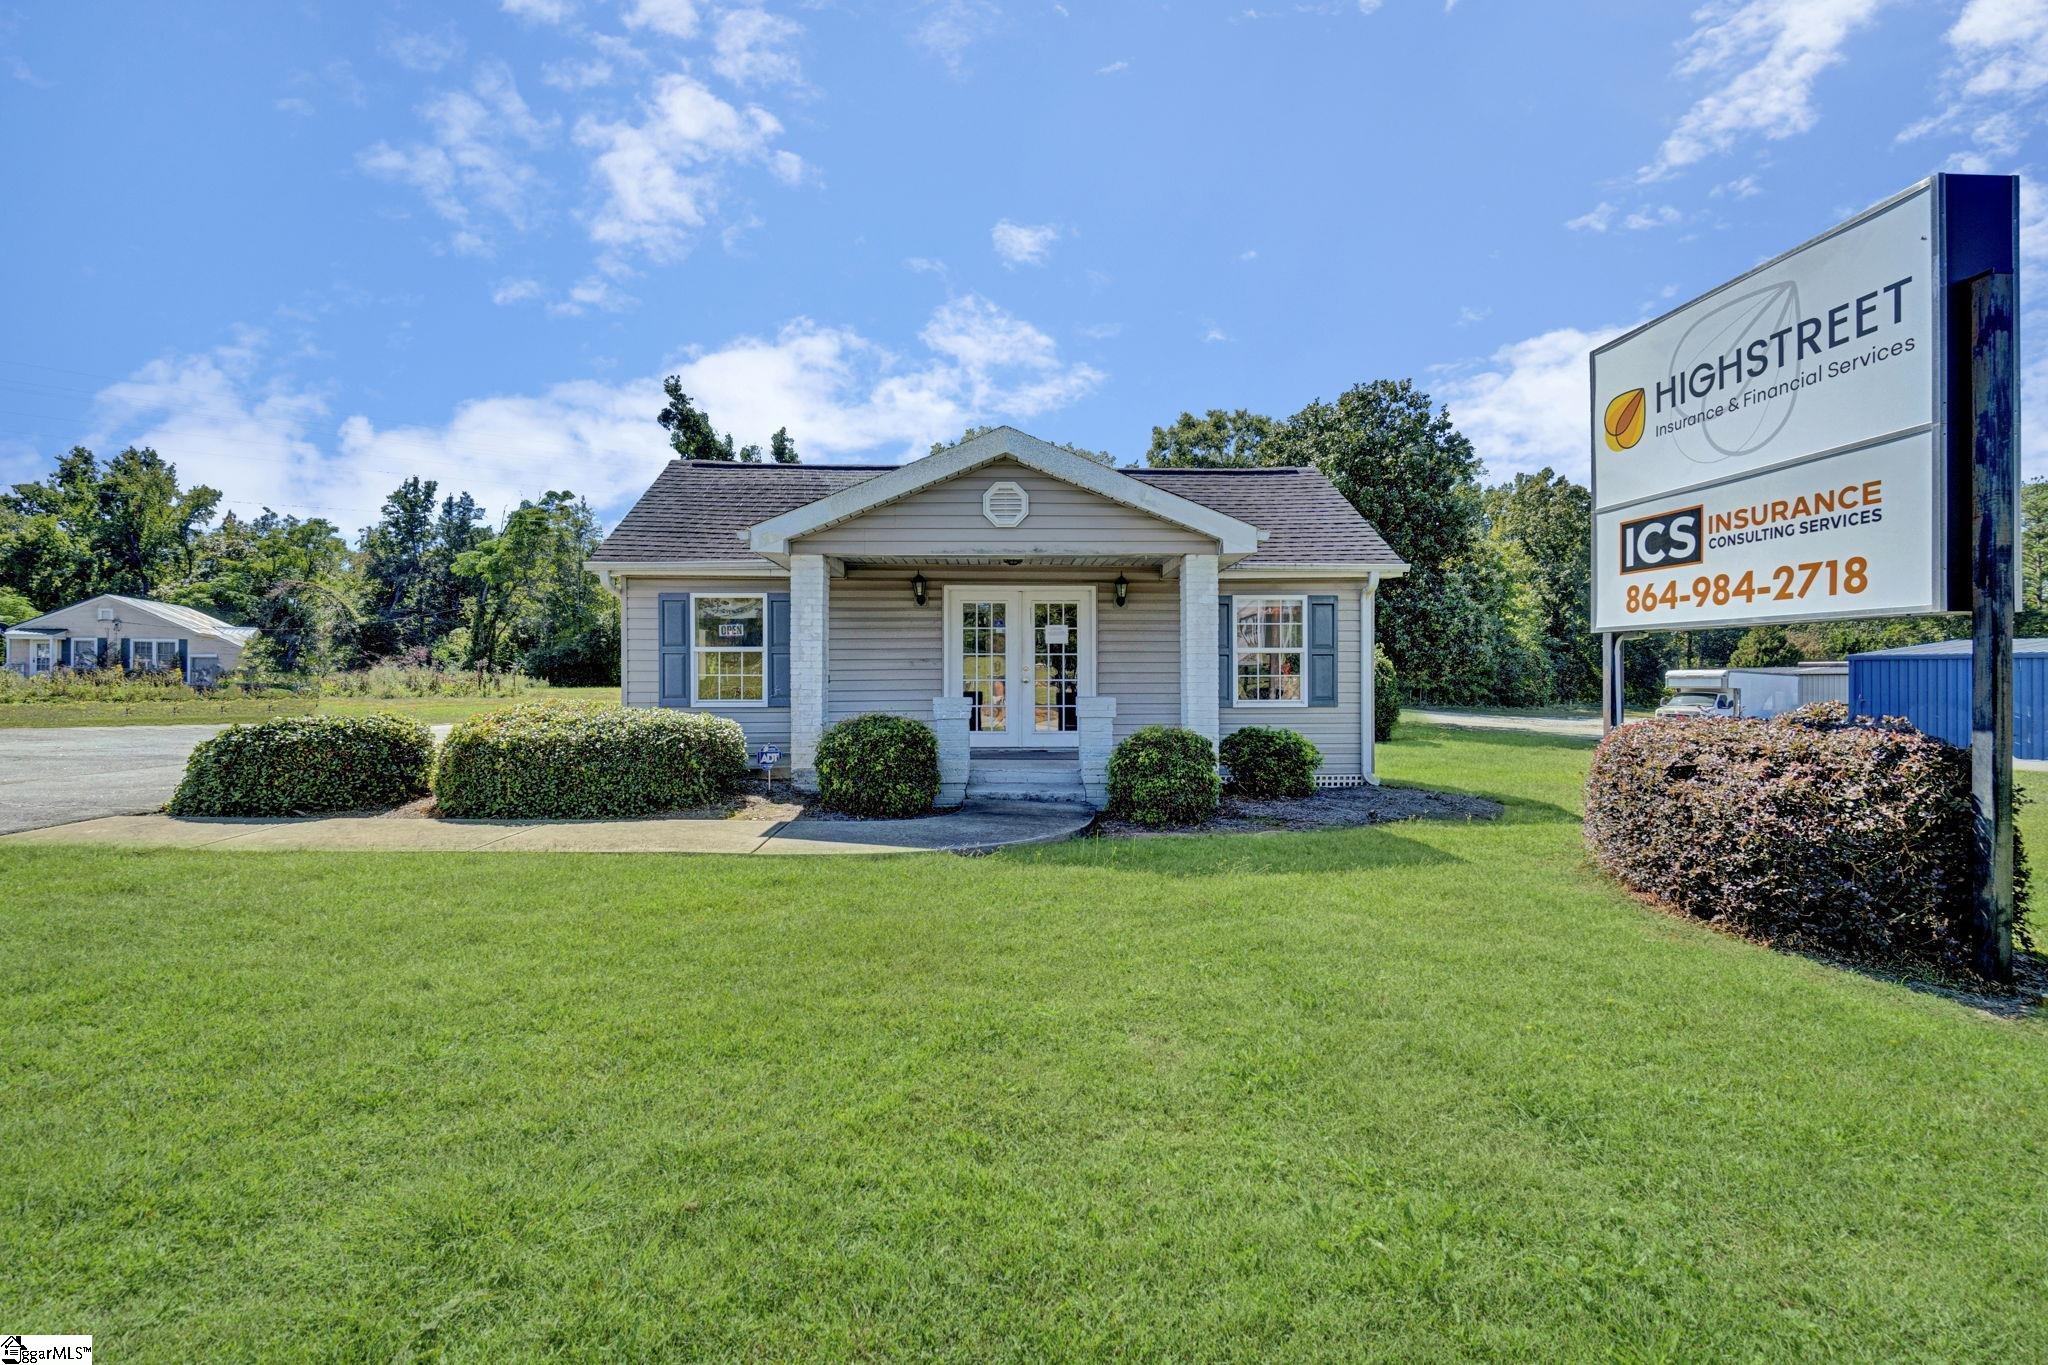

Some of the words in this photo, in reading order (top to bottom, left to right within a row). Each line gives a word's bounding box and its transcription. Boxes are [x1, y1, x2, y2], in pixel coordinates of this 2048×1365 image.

[1656, 276, 1912, 413] HIGHSTREET
[1655, 403, 1724, 438] Insurance
[1728, 396, 1740, 413] &
[1743, 364, 1823, 408] Financial
[1827, 336, 1916, 378] Services
[1708, 480, 1883, 535] INSURANCE
[1708, 523, 1795, 550] CONSULTING
[1798, 507, 1883, 535] SERVICES
[1625, 515, 1697, 568] ICS
[1625, 555, 1869, 614] 864-984-2718
[721, 625, 742, 635] OPEN
[760, 753, 779, 763] ADT
